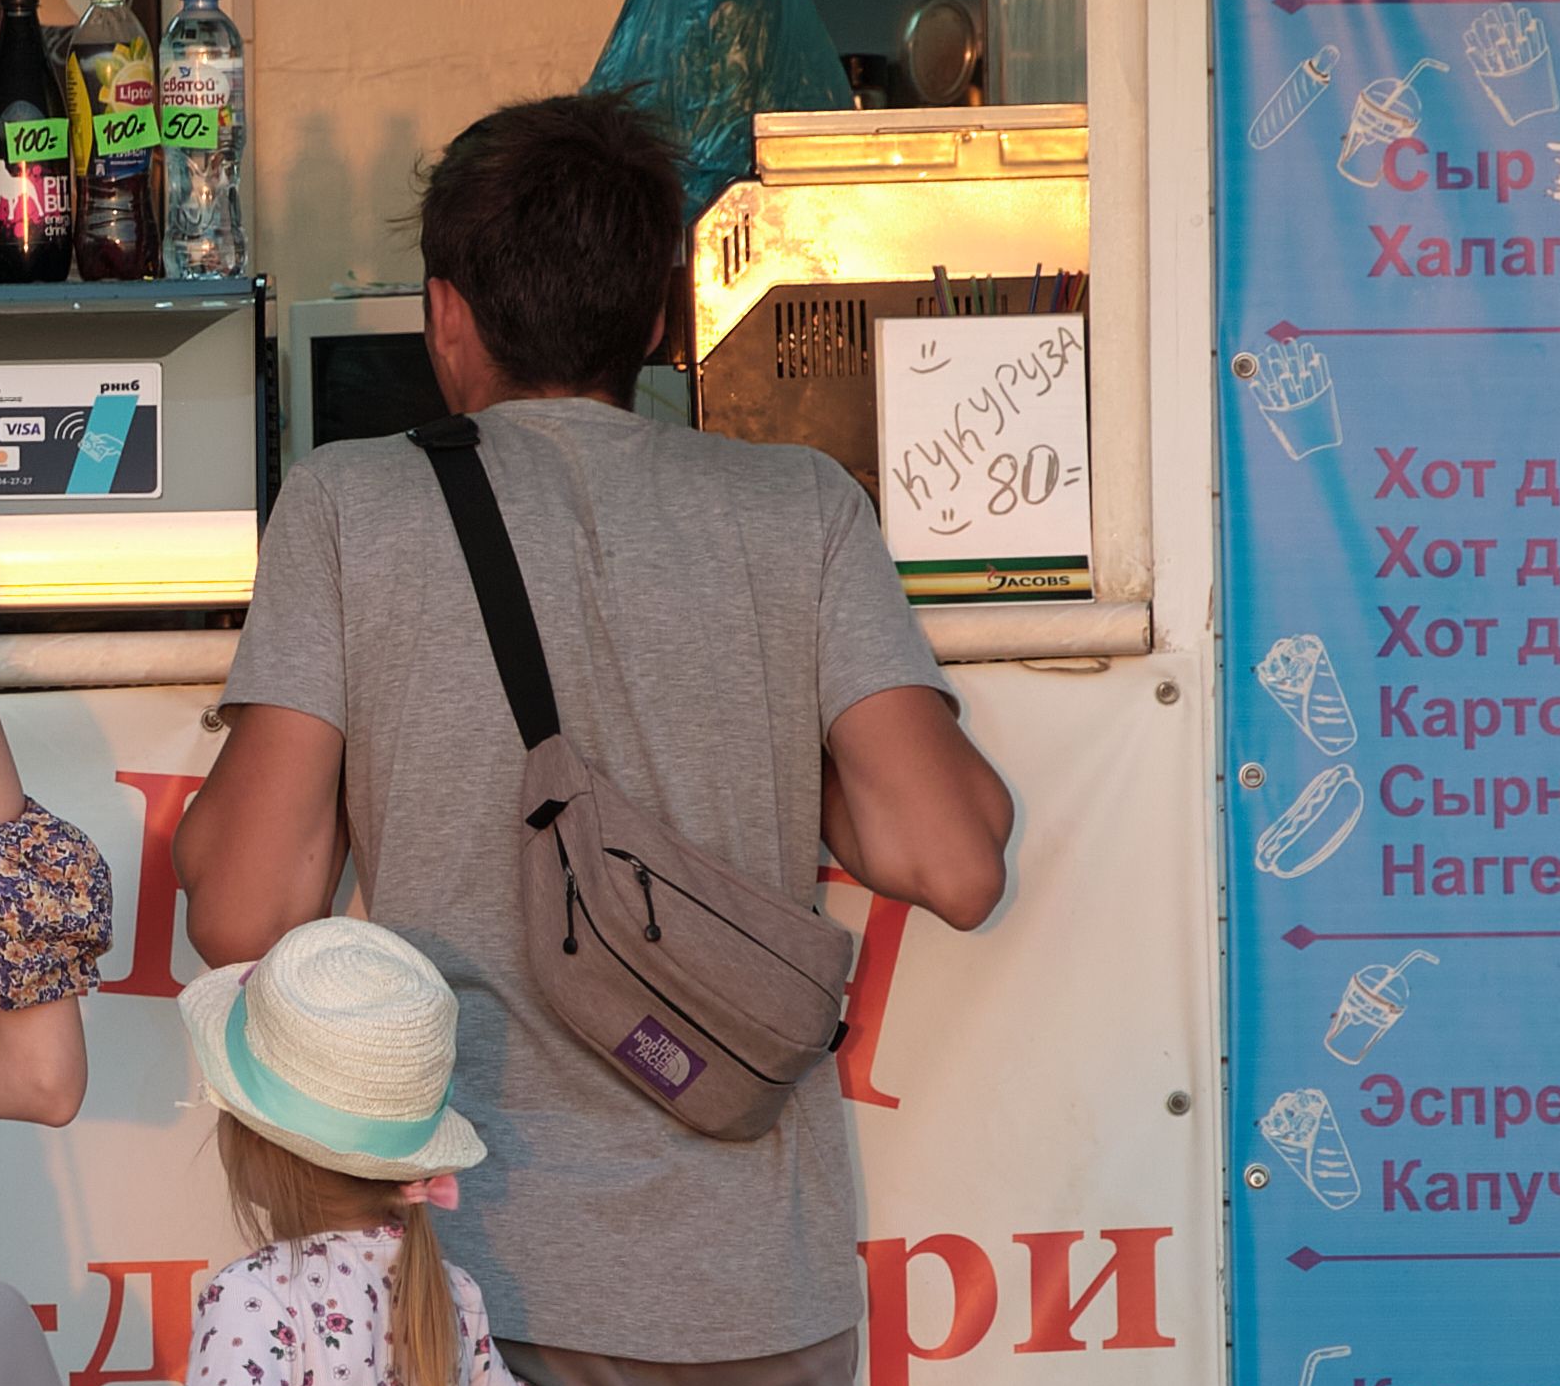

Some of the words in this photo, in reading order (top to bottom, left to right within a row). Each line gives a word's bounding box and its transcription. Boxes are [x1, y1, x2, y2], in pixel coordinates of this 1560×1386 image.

[43, 175, 68, 195] PIT
[1383, 141, 1535, 205] Сыр
[99, 379, 141, 395] рнкб
[5, 422, 41, 435] VISA
[892, 326, 1083, 511] КУКУРУЗА
[1375, 448, 1496, 501] Хот
[1375, 529, 1496, 582] Хот
[987, 573, 1071, 591] JACOBS
[1375, 608, 1496, 659] Хот
[633, 1029, 673, 1065] NORTH
[635, 1045, 668, 1074] FACE
[657, 1034, 681, 1057] THE
